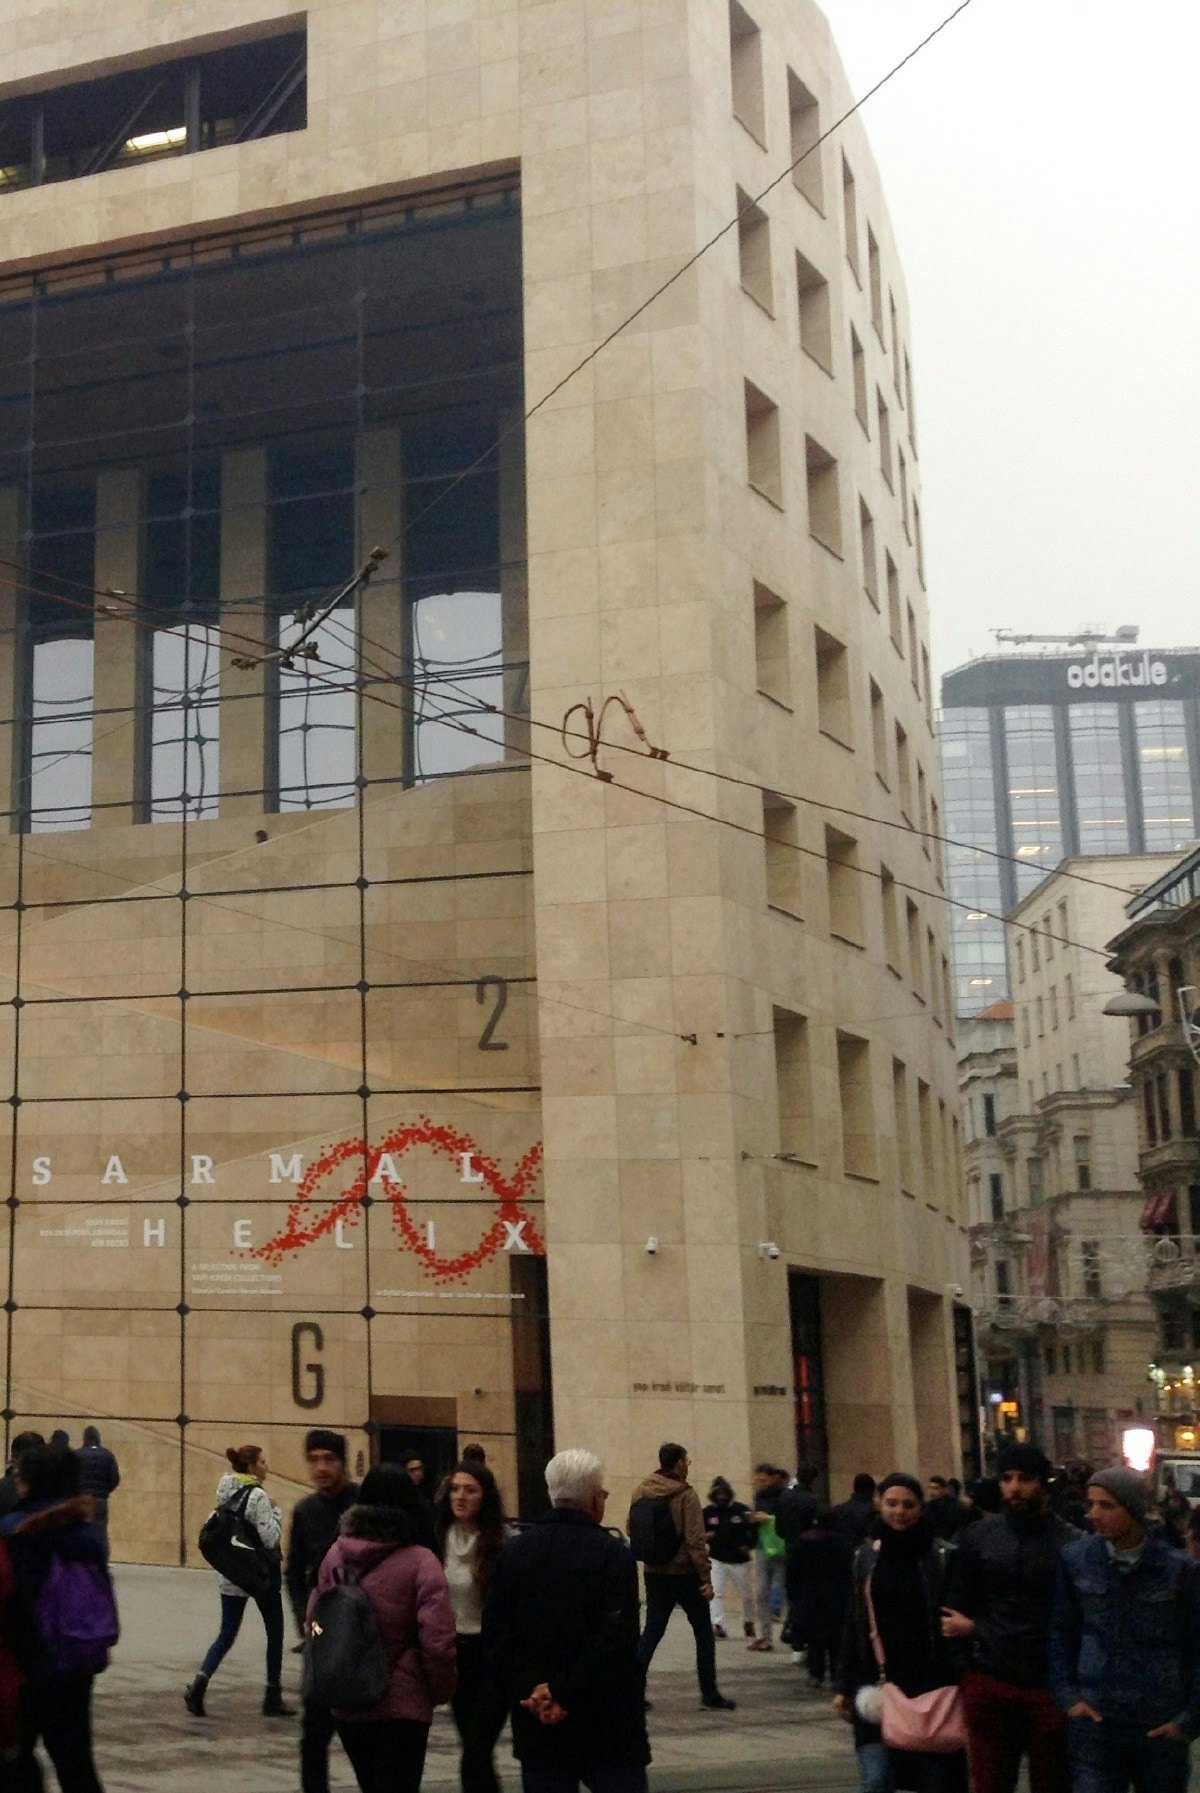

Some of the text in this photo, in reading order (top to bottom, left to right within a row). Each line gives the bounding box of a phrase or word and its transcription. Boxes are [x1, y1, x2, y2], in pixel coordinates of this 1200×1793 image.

[1066, 649, 1167, 688] odakule
[476, 974, 509, 1051] 2
[31, 1151, 485, 1185] SARMAL
[143, 1218, 531, 1251] HELIX
[291, 1321, 324, 1410] G
